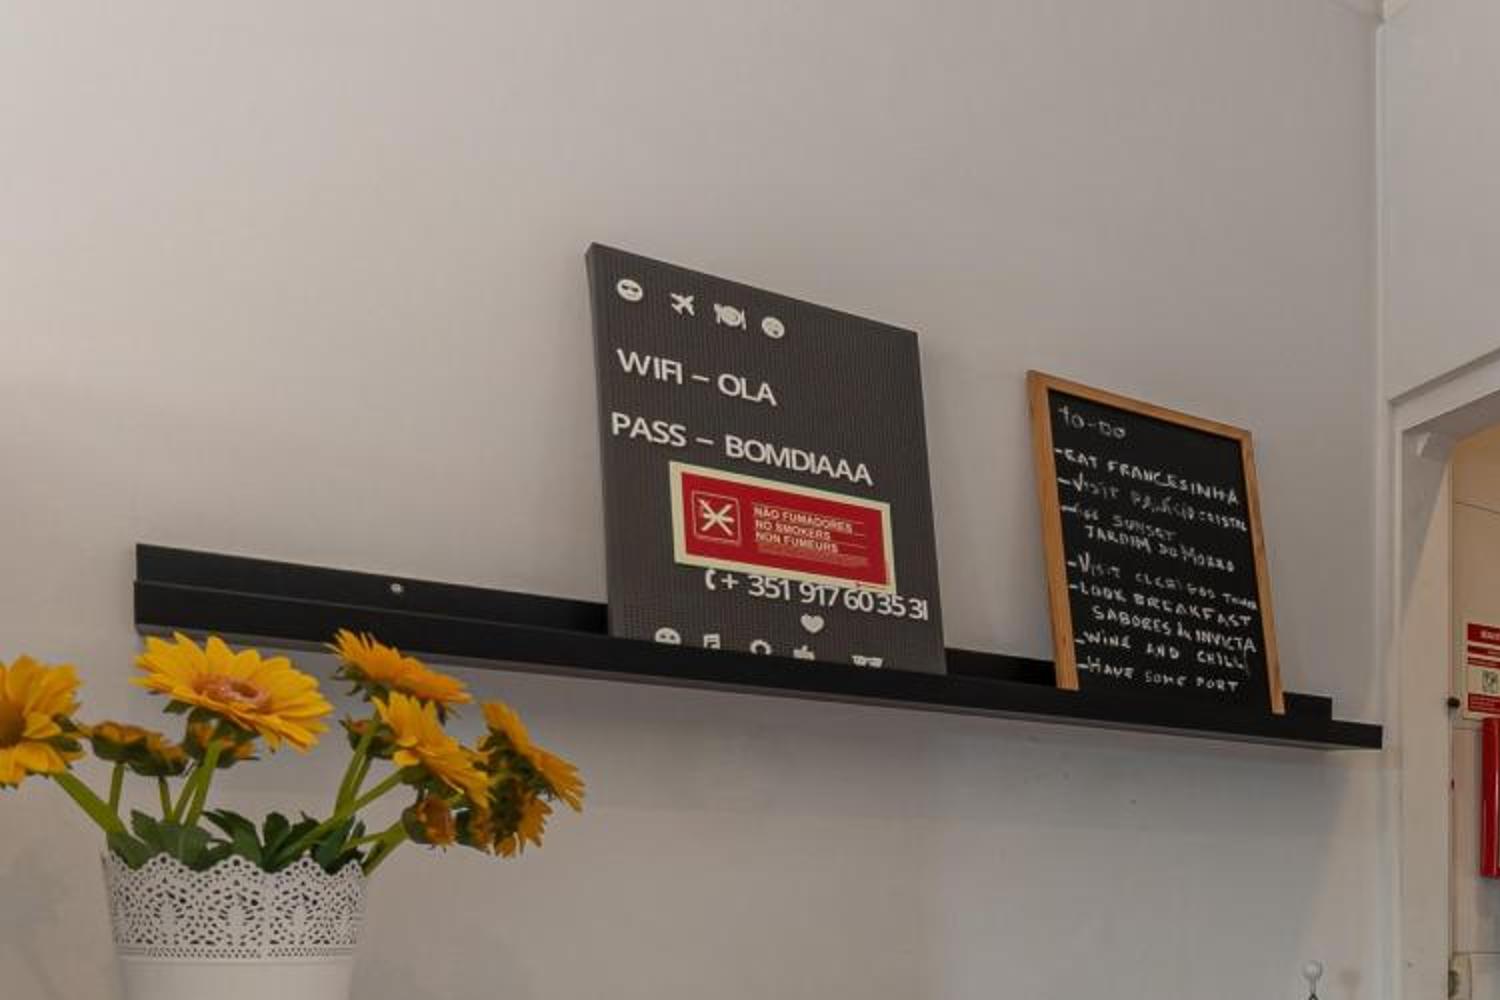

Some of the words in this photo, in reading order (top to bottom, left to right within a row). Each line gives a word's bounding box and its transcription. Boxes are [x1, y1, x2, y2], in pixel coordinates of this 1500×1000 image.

[617, 348, 684, 385] WIFI
[717, 372, 778, 406] OLA
[611, 411, 687, 448] PASS
[725, 434, 874, 487] BOMDIAAA
[755, 520, 773, 532] NO
[775, 523, 831, 541] SMOKERS
[782, 511, 853, 535] FUMADORES
[755, 531, 781, 544] NON
[783, 535, 839, 553] FUMEURS
[1091, 604, 1172, 637] SABORES
[1132, 592, 1253, 628] BREAKFAST
[1146, 642, 1180, 660] AND
[1196, 675, 1240, 693] PORT
